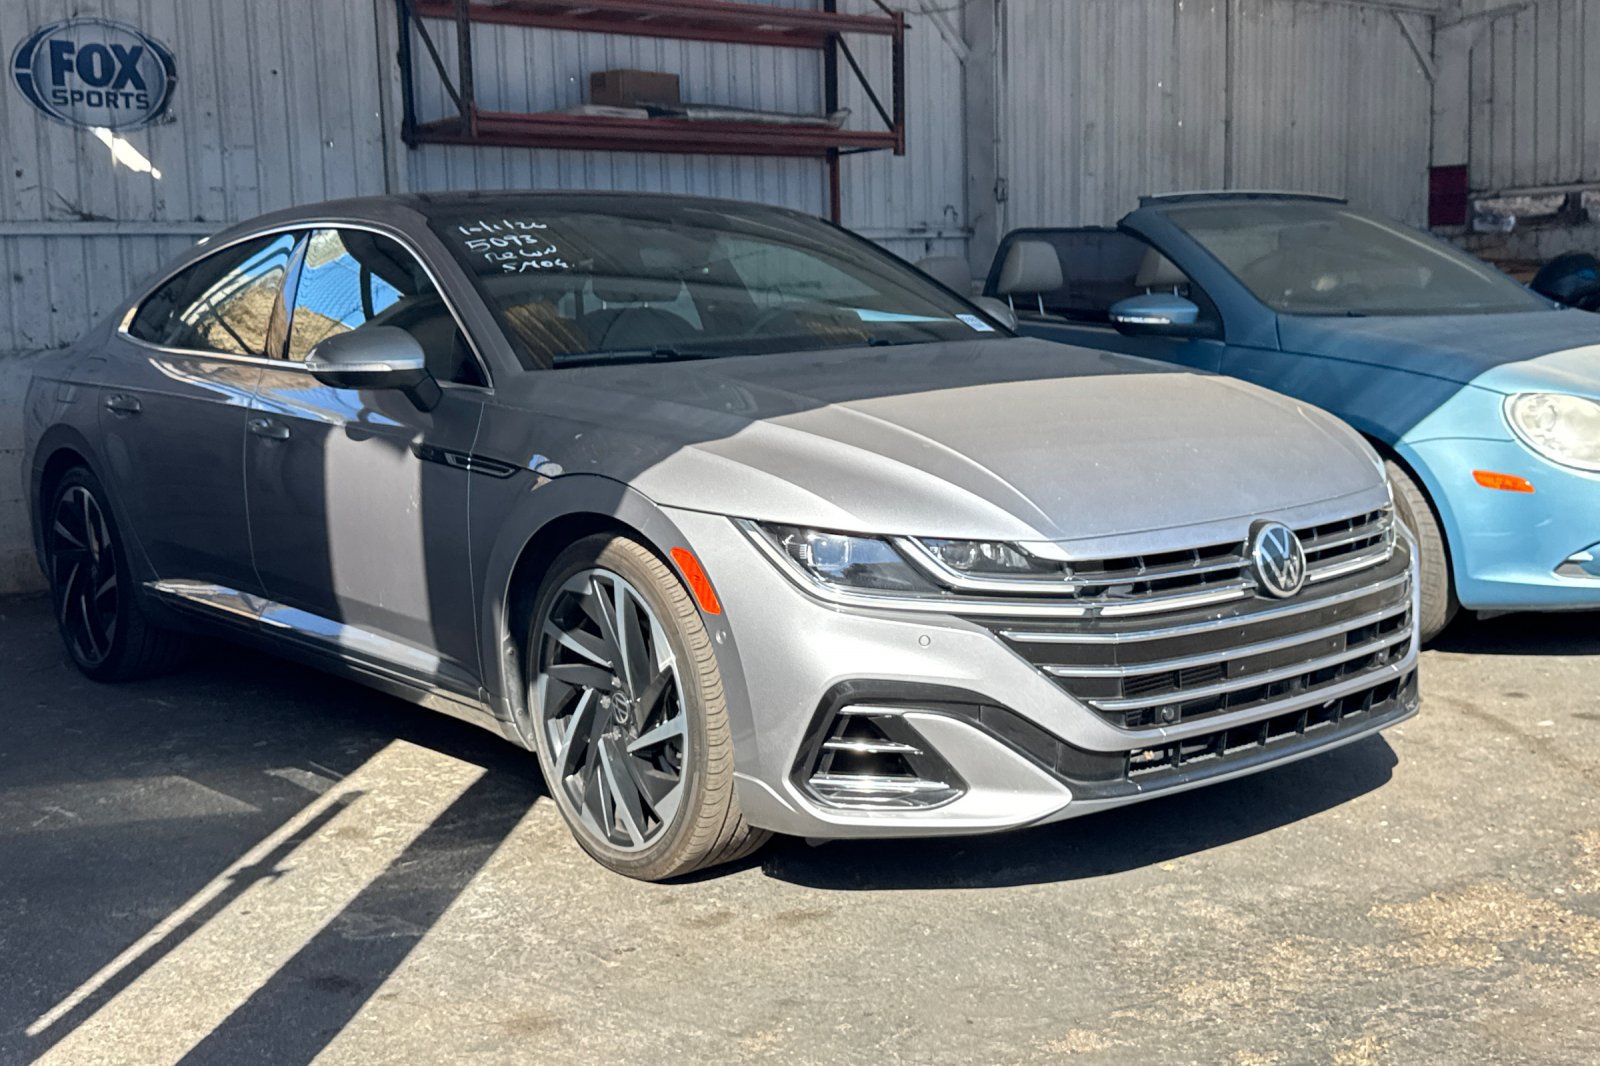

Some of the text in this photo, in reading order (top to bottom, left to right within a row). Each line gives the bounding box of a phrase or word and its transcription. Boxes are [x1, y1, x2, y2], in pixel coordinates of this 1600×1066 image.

[50, 39, 147, 91] FOX
[52, 89, 149, 110] SPORTS
[465, 234, 537, 252] 5093
